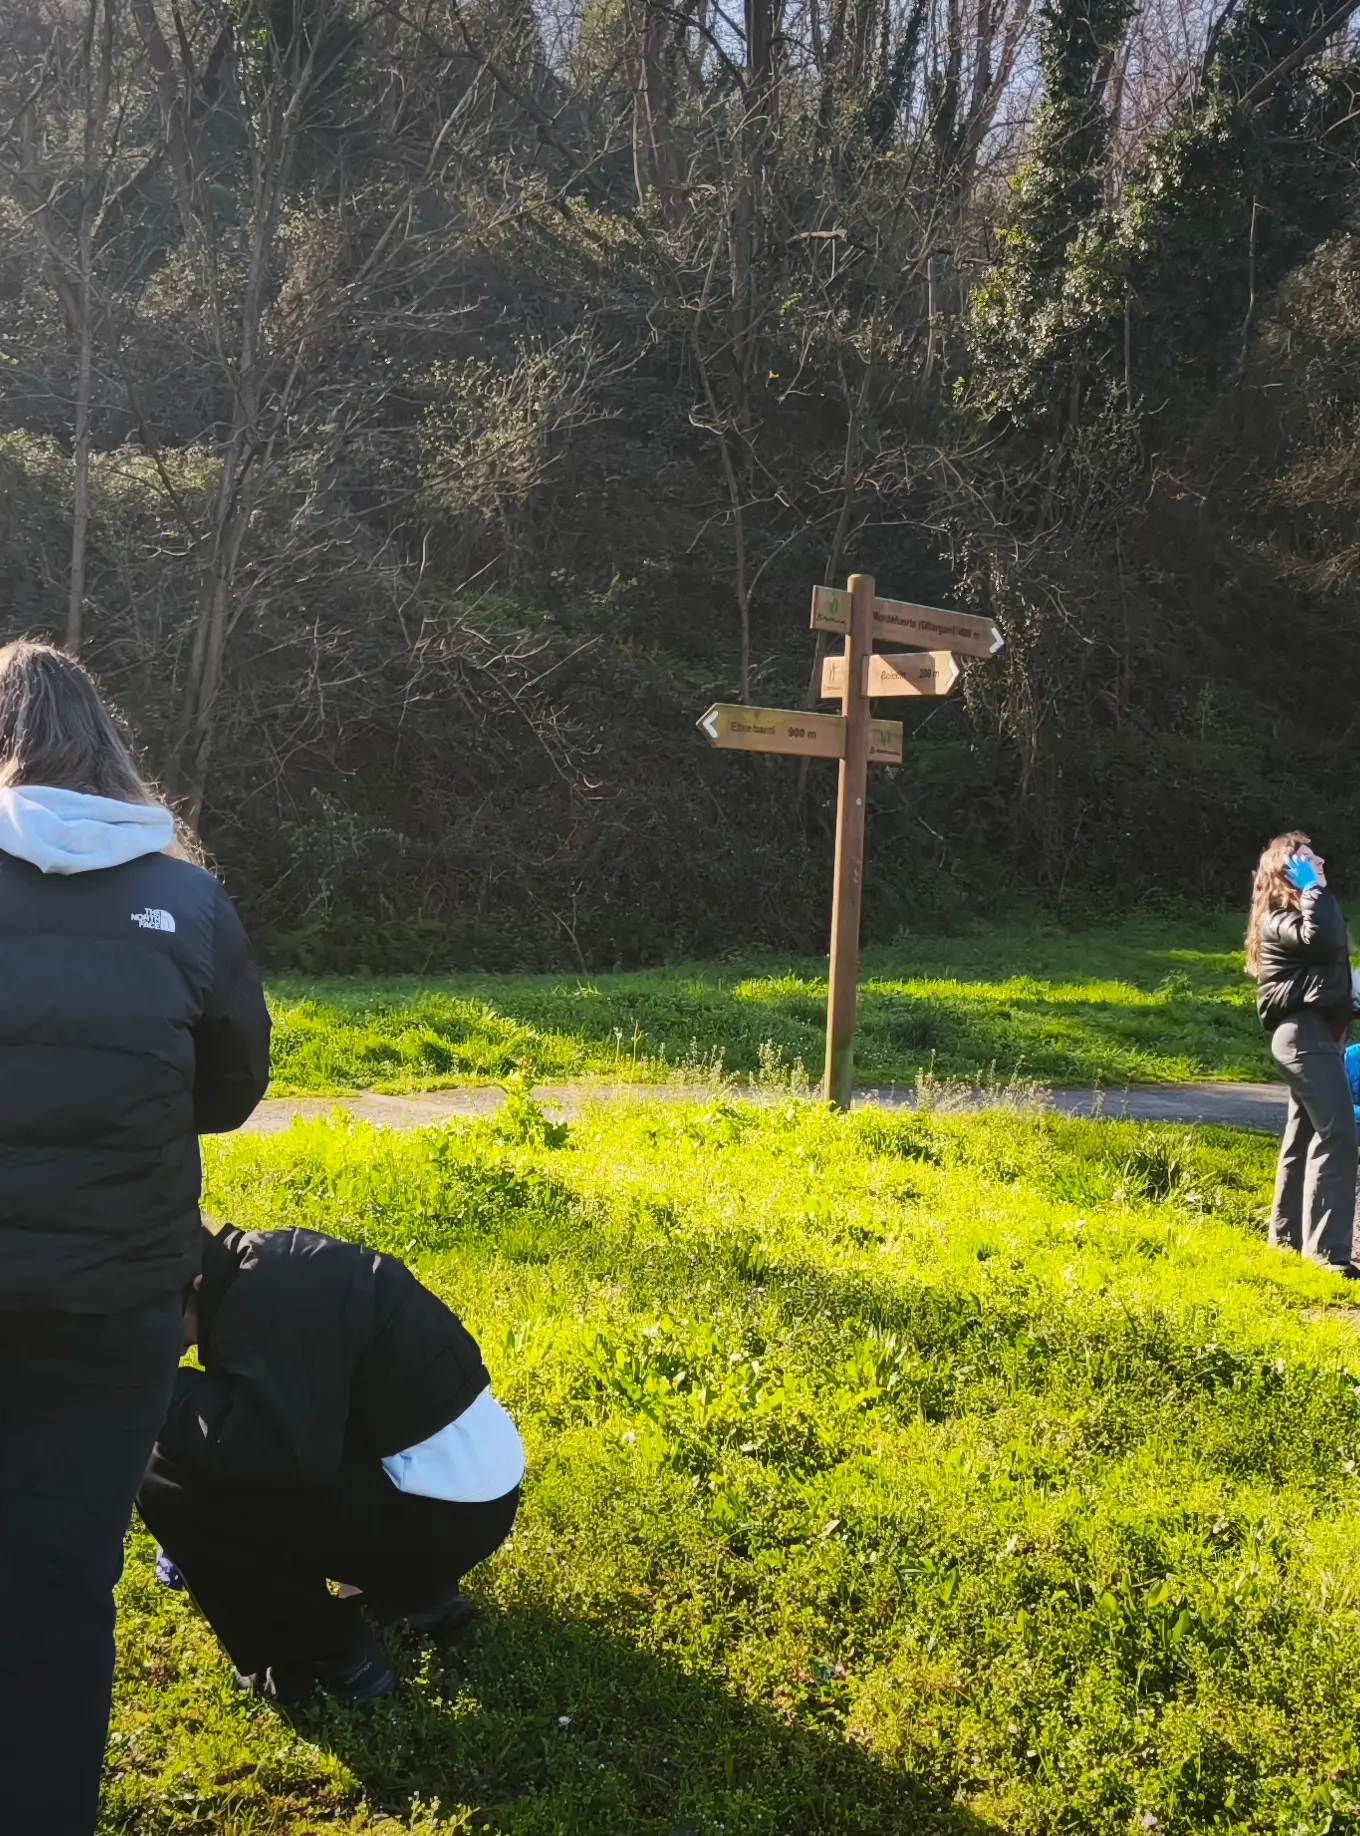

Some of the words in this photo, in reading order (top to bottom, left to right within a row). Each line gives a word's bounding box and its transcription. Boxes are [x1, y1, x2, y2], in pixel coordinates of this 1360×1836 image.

[788, 726, 805, 739] 900
[807, 731, 817, 739] m
[144, 907, 161, 917] THE
[130, 913, 161, 923] NORTH
[139, 919, 161, 930] FACE
